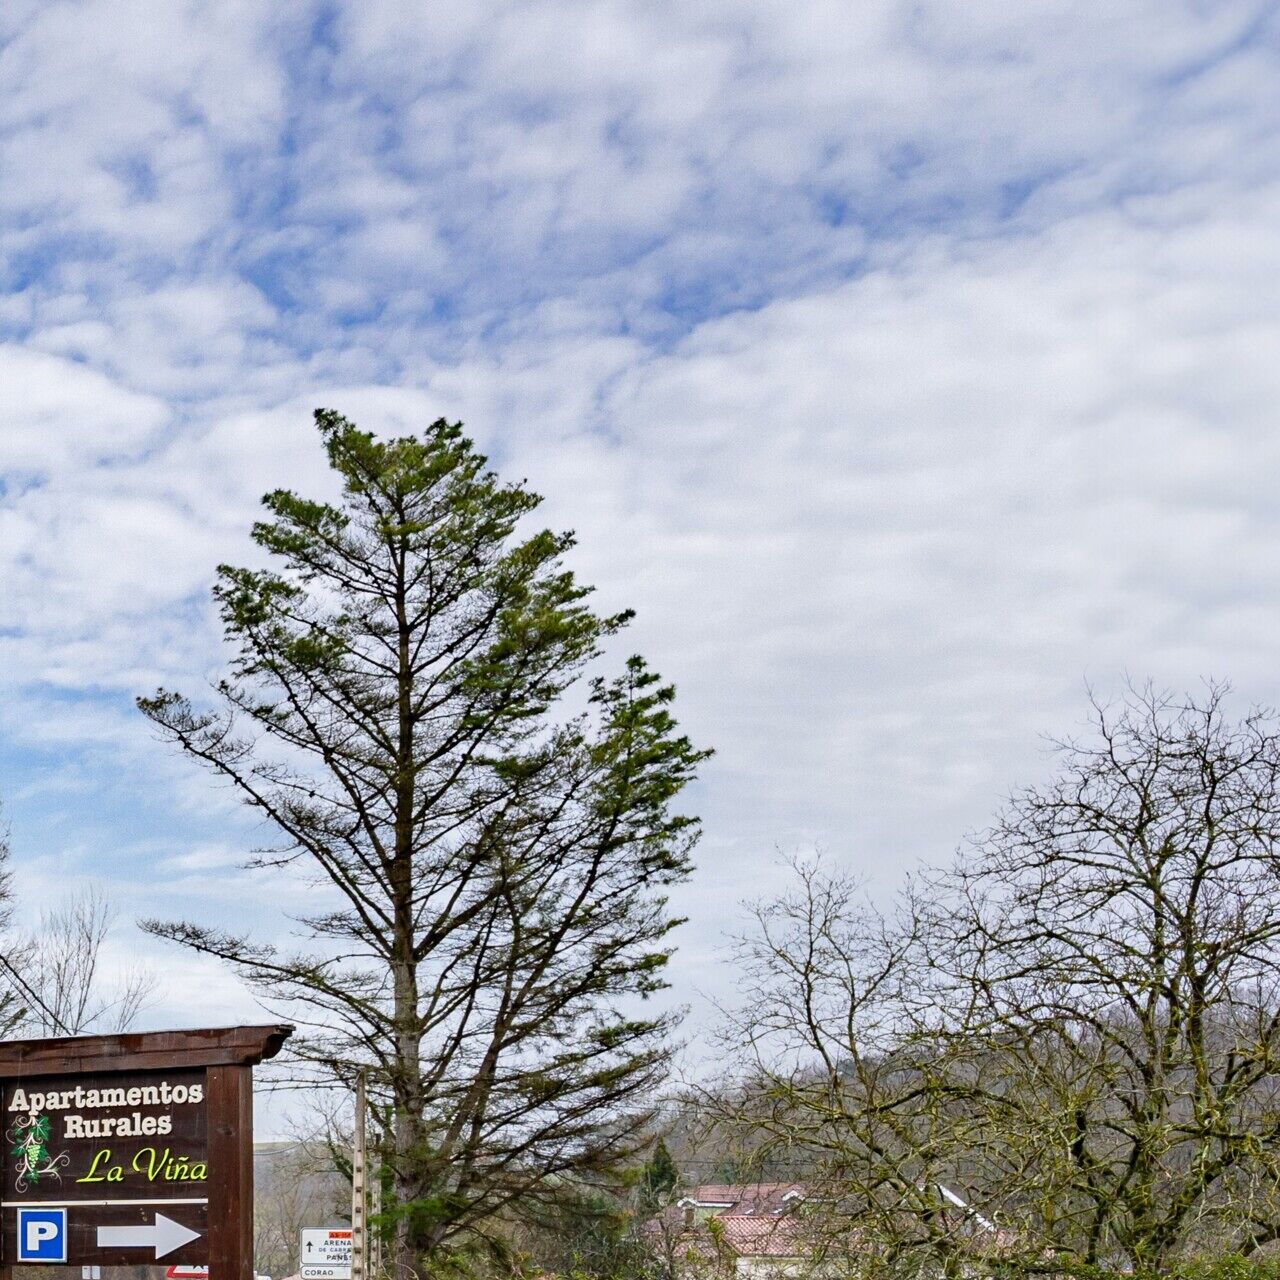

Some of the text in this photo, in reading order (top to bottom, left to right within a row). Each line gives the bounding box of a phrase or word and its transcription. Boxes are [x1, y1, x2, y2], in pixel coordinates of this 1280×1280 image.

[8, 1081, 204, 1116] Apartamentos
[63, 1112, 172, 1139] Rurales
[75, 1147, 208, 1183] La Viña
[26, 1221, 58, 1251] P
